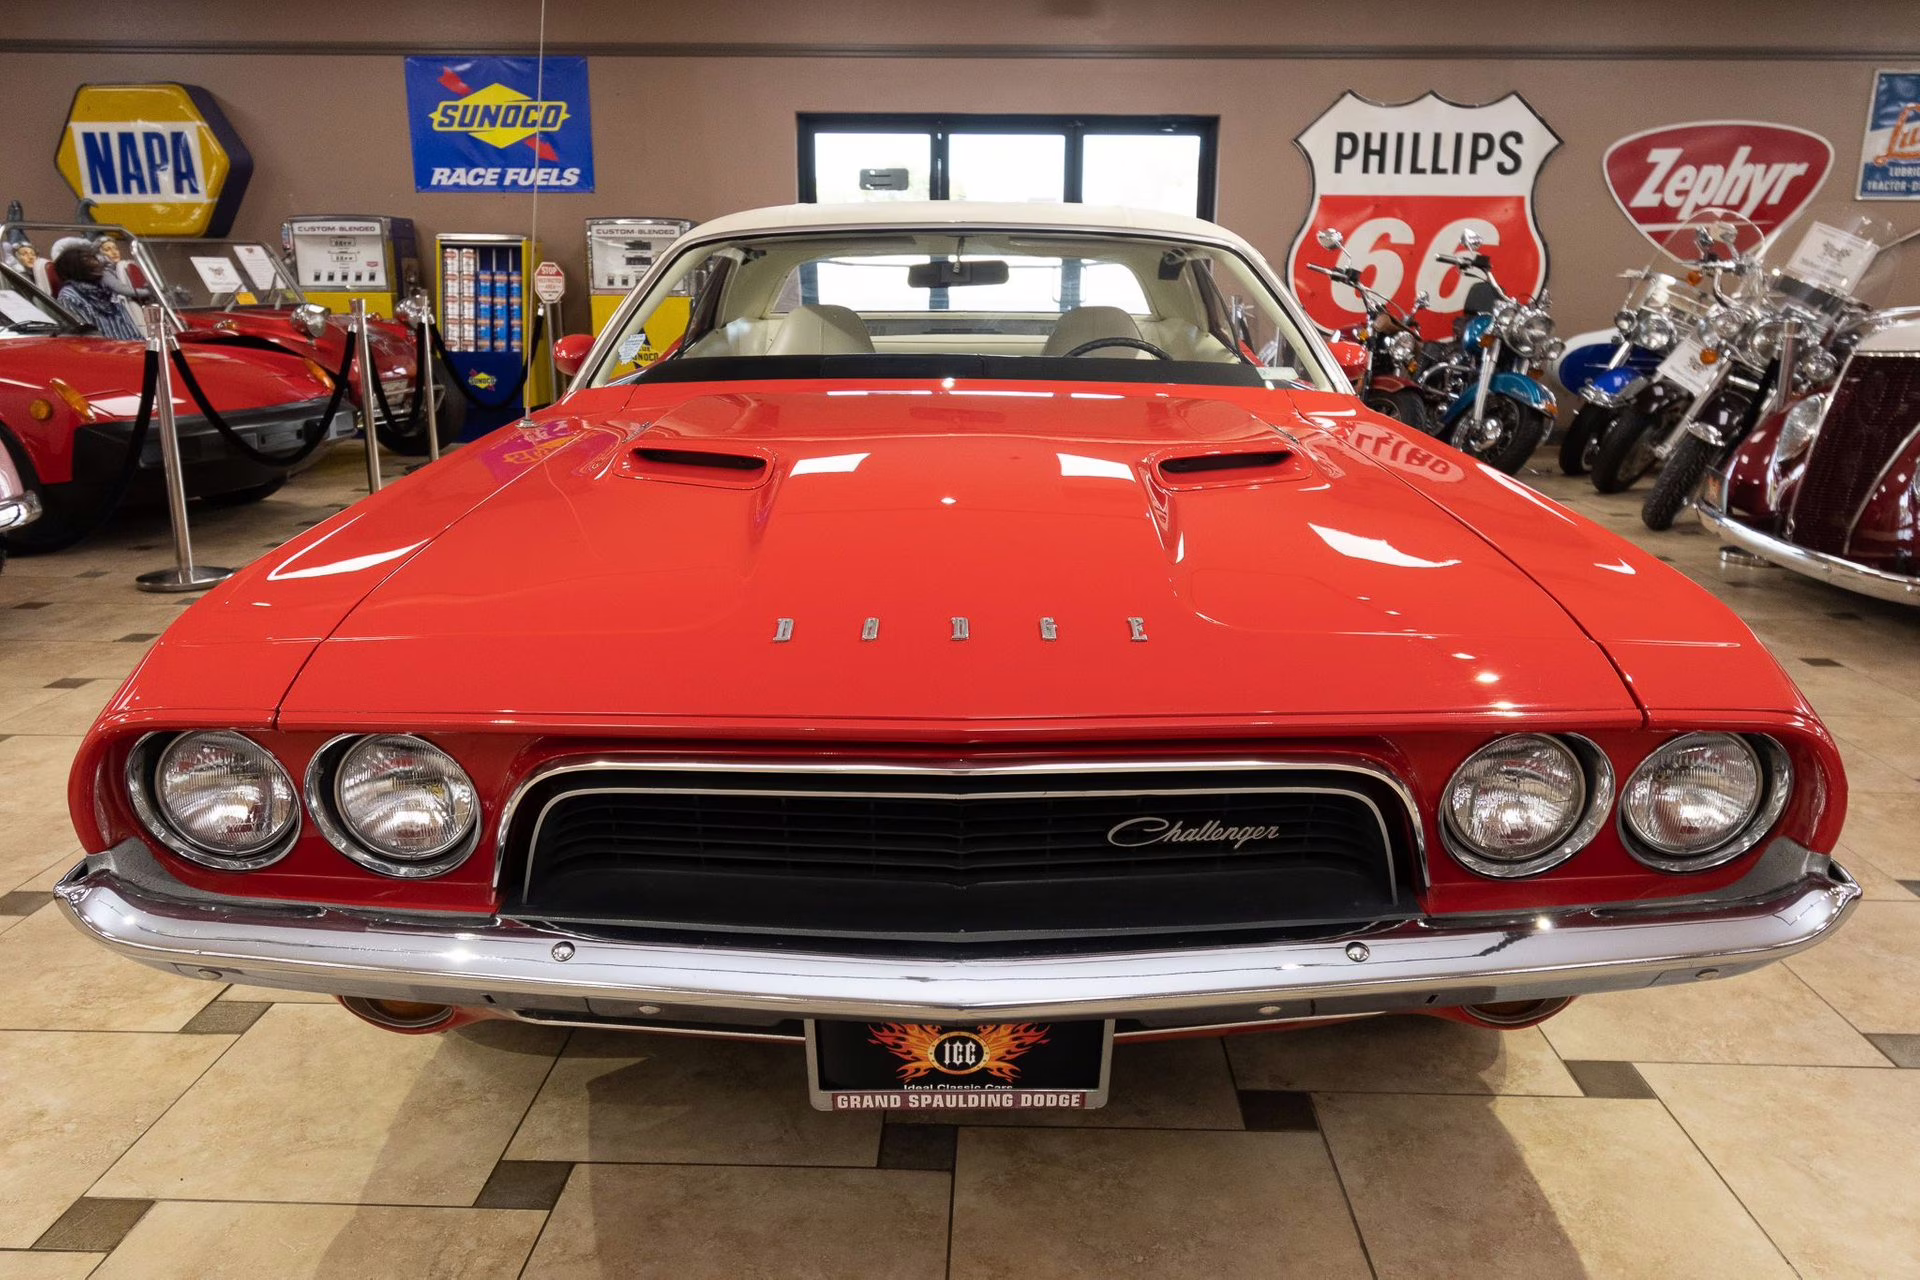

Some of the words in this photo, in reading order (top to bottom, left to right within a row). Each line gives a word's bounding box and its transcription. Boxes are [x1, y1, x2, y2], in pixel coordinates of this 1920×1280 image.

[437, 104, 563, 128] SUNOCO
[82, 131, 199, 194] NAPA
[1334, 130, 1524, 176] PHILLIPS
[431, 167, 501, 186] RACE
[503, 167, 581, 186] FUELS
[1630, 145, 1809, 221] Zephyr
[541, 266, 557, 275] STOP
[1331, 216, 1500, 314] 66
[635, 352, 659, 361] NOCO
[772, 616, 1149, 643] DODGE
[1107, 816, 1280, 850] Challenger
[944, 1041, 976, 1066] ICC
[837, 1094, 901, 1108] GRAND
[908, 1093, 1013, 1108] SPAULDING
[1020, 1093, 1080, 1107] DODGE
